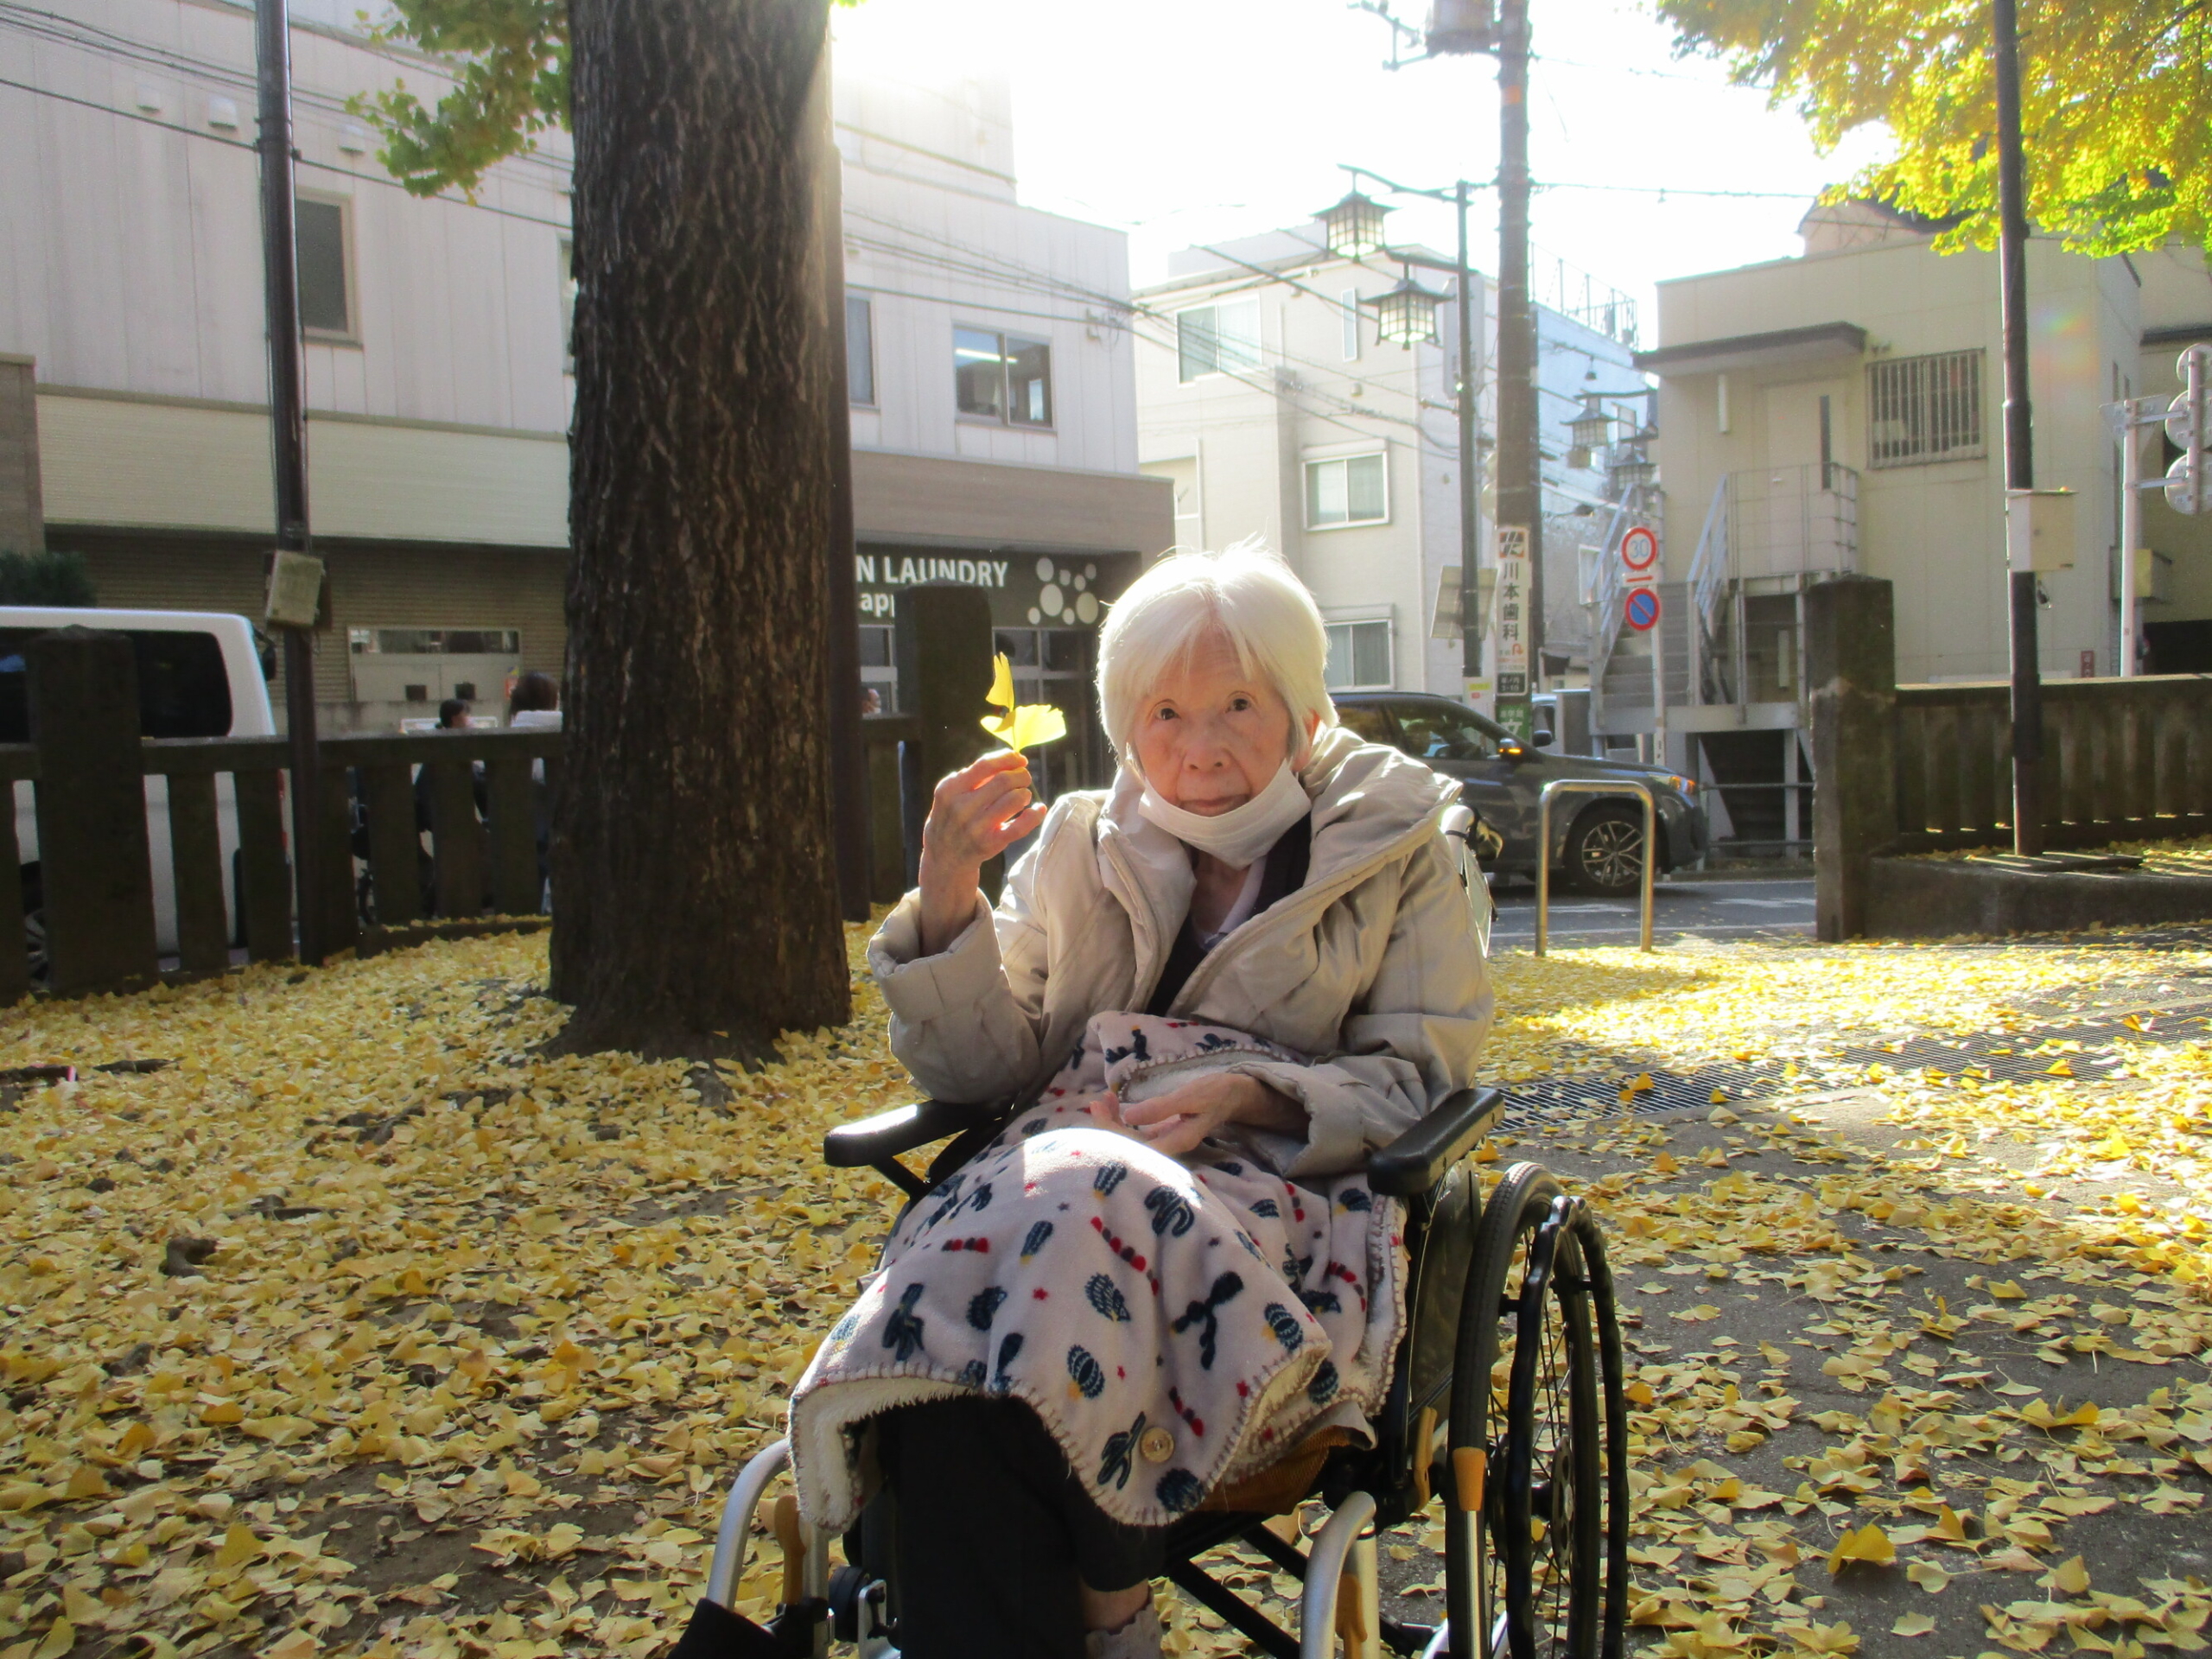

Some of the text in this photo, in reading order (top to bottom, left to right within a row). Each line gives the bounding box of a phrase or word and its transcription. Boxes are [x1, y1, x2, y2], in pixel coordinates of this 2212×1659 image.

[1630, 538, 1649, 558] 30
[883, 556, 1008, 588] LAUNDRY
[1503, 562, 1520, 641] 川本歯科
